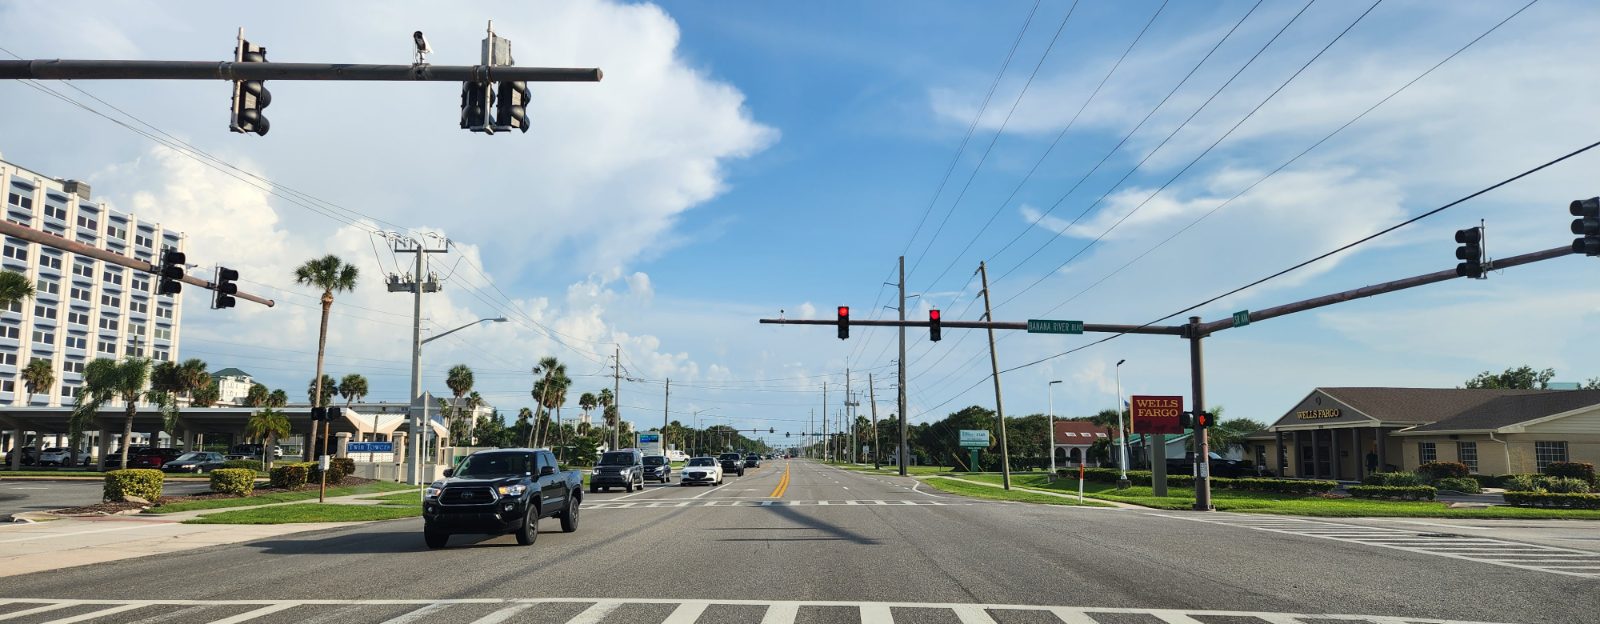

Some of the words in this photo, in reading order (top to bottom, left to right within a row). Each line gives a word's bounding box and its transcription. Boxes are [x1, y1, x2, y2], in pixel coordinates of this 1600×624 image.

[1029, 321, 1051, 331] BANANA
[1053, 322, 1070, 332] RIVER
[1136, 399, 1179, 408] WELLS
[1137, 408, 1179, 417] FARGO
[1296, 411, 1318, 419] WELLS
[1318, 409, 1339, 418] FARGO
